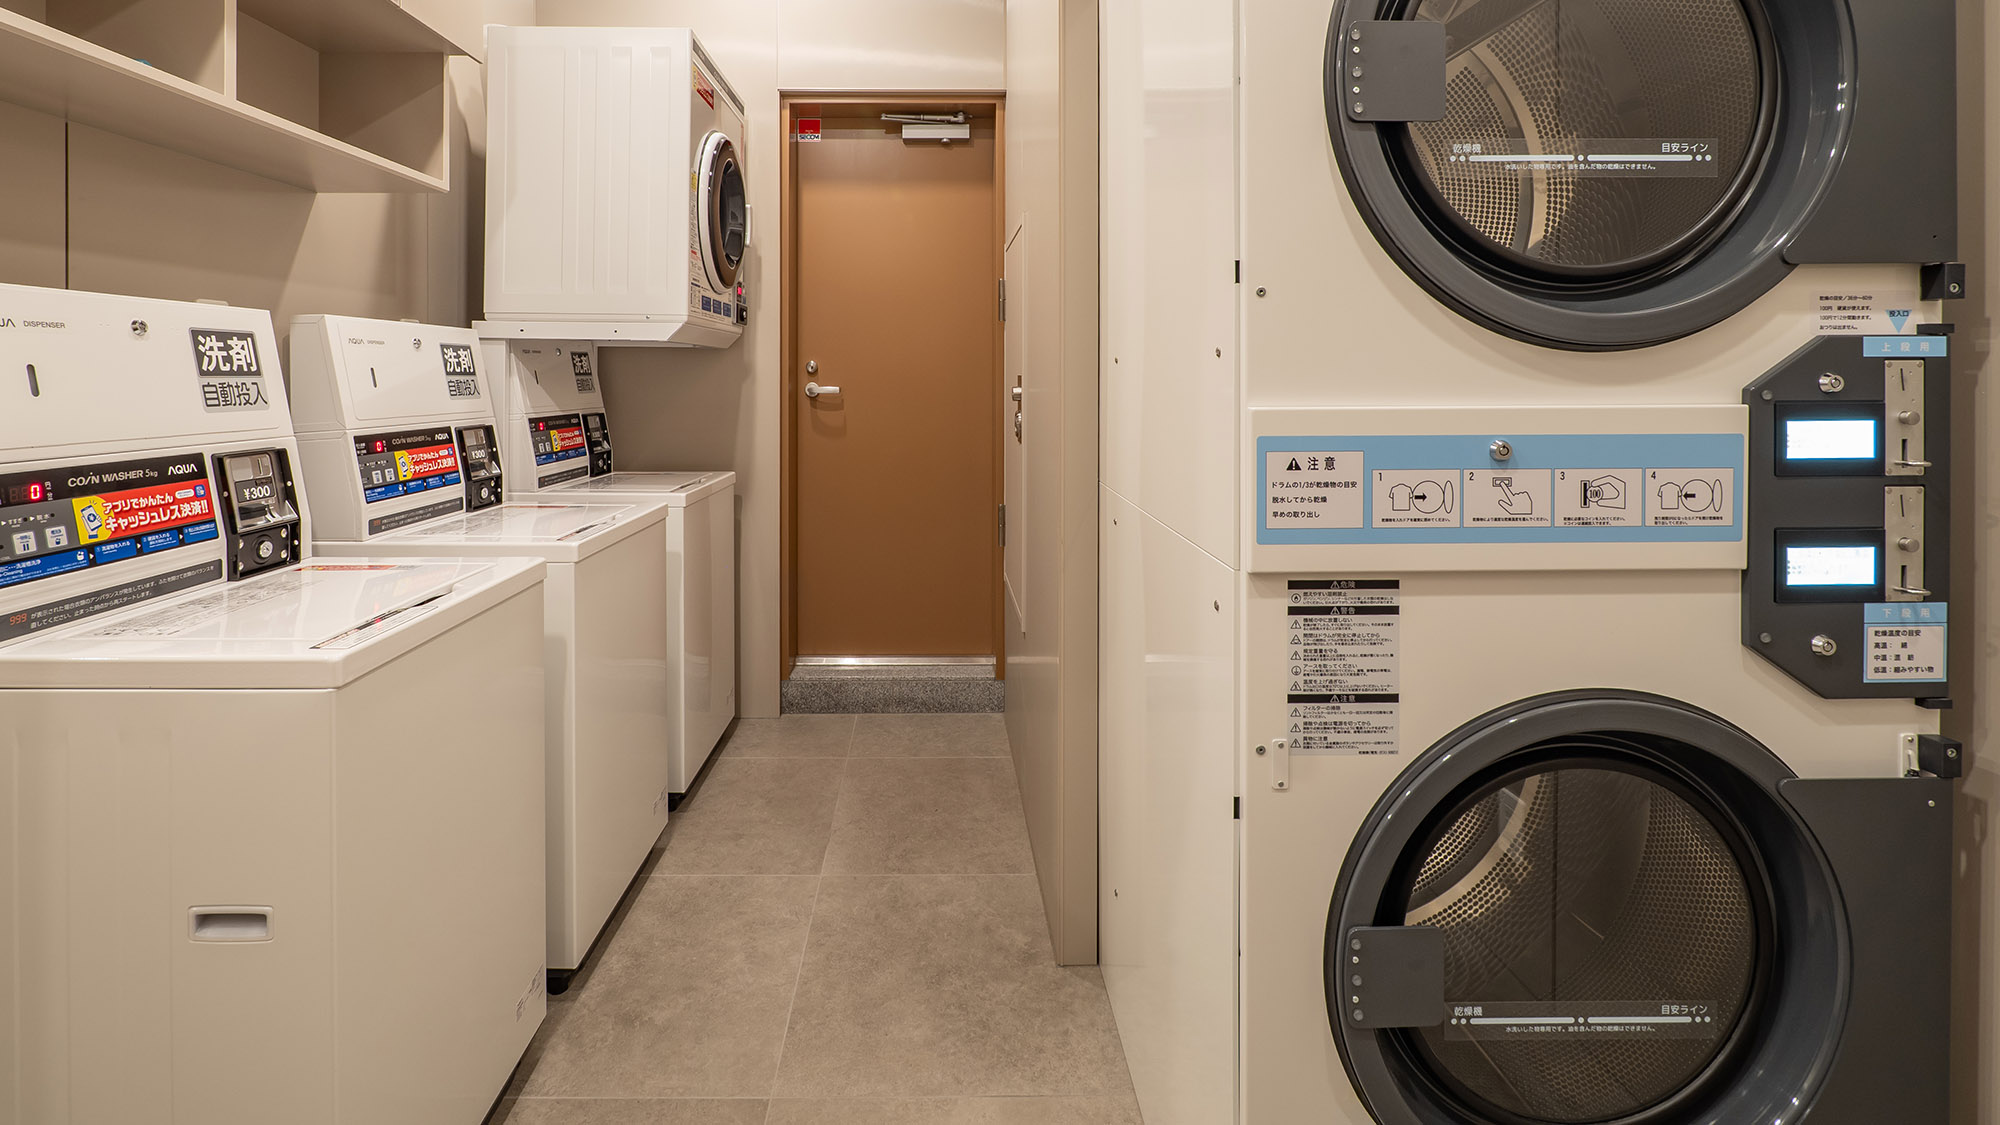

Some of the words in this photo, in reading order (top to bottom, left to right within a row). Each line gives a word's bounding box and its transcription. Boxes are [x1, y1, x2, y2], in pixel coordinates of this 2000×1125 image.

[1453, 143, 1481, 154] 乾燥機
[1661, 142, 1708, 153] 目安ライン
[1889, 310, 1909, 318] 投入口
[23, 320, 66, 329] DISPENSER
[197, 335, 258, 372] 洗剤
[443, 348, 474, 373] 洗剤
[447, 379, 480, 397] 自動投入
[202, 382, 268, 407] 自動投入
[434, 433, 449, 441] AQUA
[102, 469, 143, 483] WASHER
[145, 469, 158, 479] 5kg
[168, 463, 197, 475] AQUA
[1378, 472, 1383, 481] 1
[1468, 472, 1475, 481] 2
[1560, 471, 1566, 480] 3
[1651, 471, 1657, 480] 4
[1271, 481, 1357, 489] ドラムの1/3が乾燥物の目安
[31, 485, 40, 499] 0
[243, 485, 271, 500] ¥300
[1588, 489, 1601, 499] 100
[102, 493, 173, 514] アプリでかんたん
[1271, 496, 1328, 504] 脱水してから乾燥
[1272, 511, 1320, 519] 早めの取り出し
[1454, 1006, 1482, 1016] 乾燥機
[1661, 1004, 1708, 1015] 目安ライン
